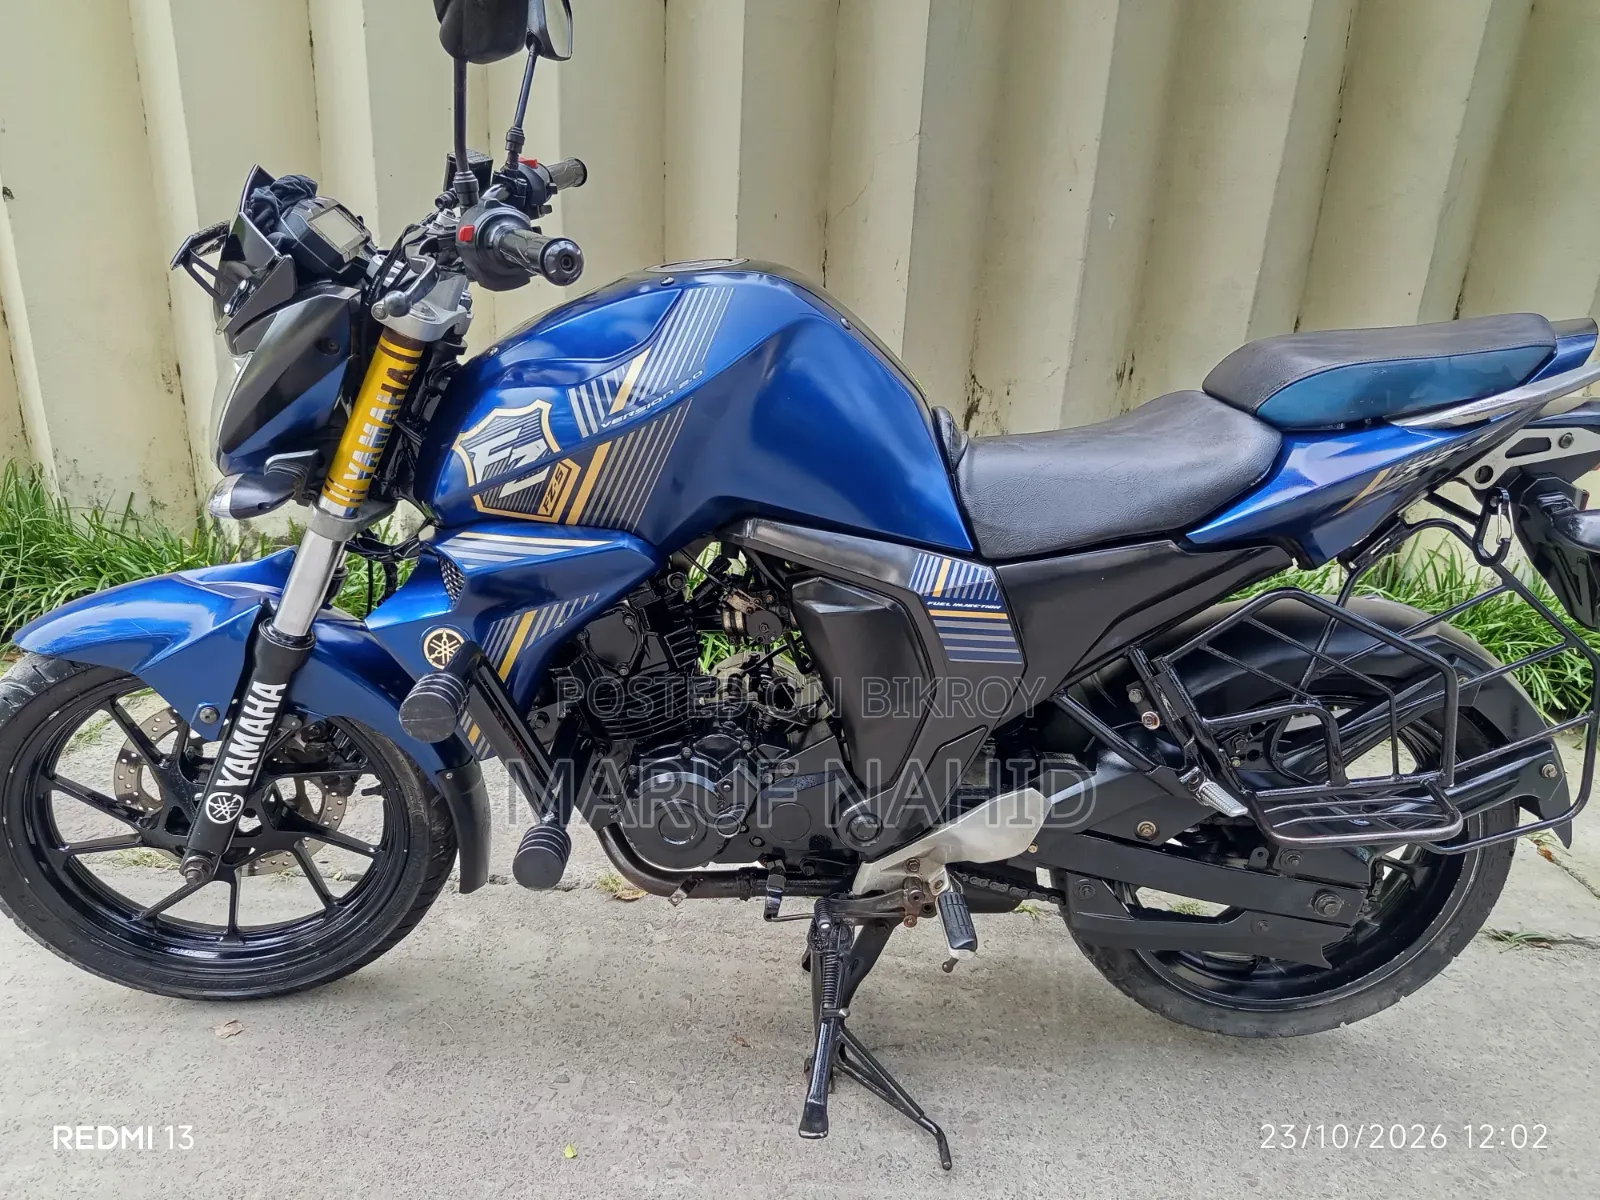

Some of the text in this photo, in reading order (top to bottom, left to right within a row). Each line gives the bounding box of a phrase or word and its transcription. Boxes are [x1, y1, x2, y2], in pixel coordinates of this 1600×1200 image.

[678, 370, 703, 390] 2.0
[343, 366, 417, 480] YAMAHA
[952, 602, 1002, 610] INJECTION
[215, 680, 287, 787] YAMAHA
